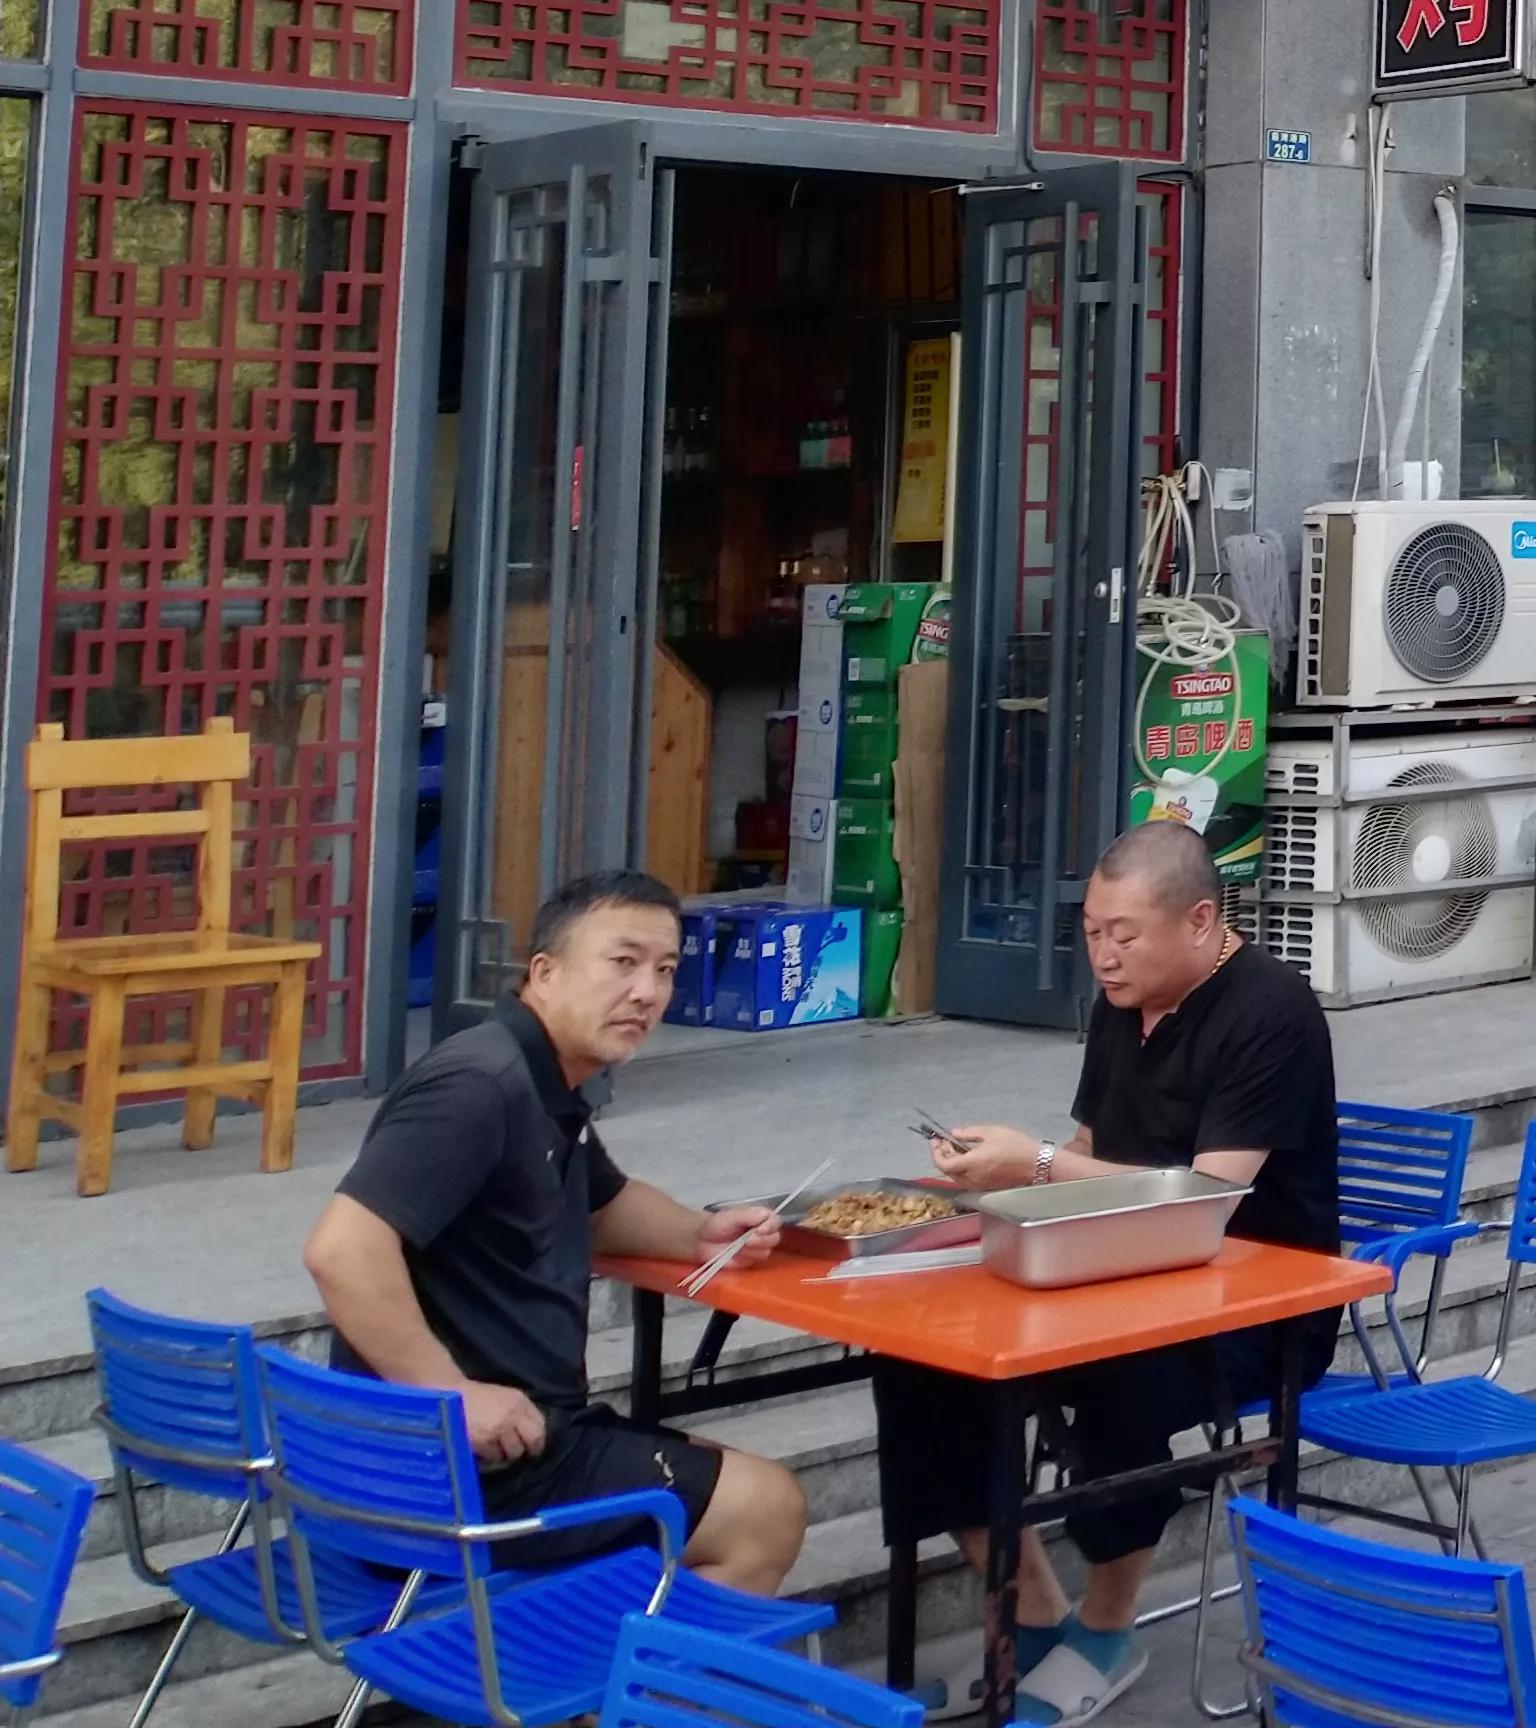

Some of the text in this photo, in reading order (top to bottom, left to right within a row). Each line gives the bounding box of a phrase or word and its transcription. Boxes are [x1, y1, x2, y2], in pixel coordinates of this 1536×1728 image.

[919, 621, 950, 640] TSING
[1174, 677, 1232, 695] TSINGTAO
[1146, 717, 1255, 762] 青岛啤酒
